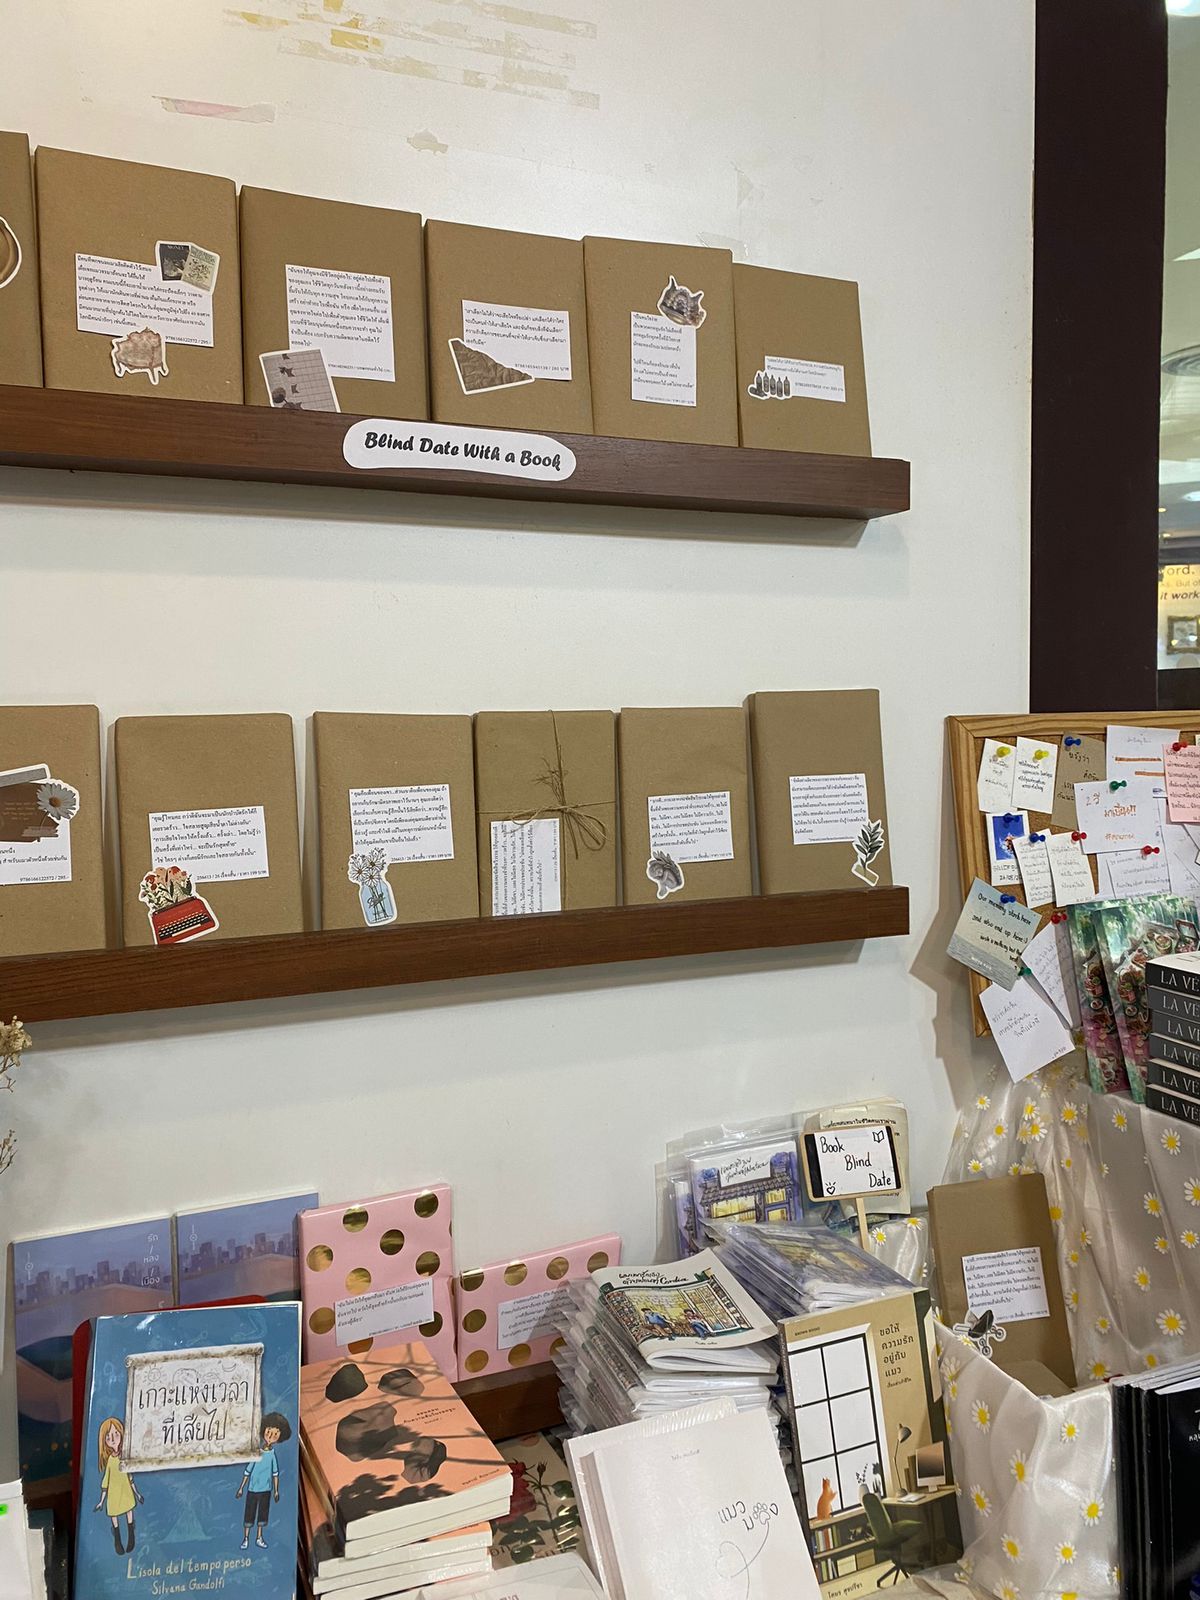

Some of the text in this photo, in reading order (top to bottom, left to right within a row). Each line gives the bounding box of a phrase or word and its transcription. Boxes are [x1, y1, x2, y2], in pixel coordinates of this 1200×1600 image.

[365, 431, 561, 472] Blind Date With a Book
[1161, 971, 1177, 986] LA
[1163, 996, 1179, 1012] LA
[1168, 1020, 1183, 1036] LA
[1163, 1044, 1179, 1060] LA
[1162, 1071, 1178, 1088] LA
[1161, 1097, 1177, 1114] LA
[820, 1136, 845, 1154] Book
[844, 1152, 872, 1171] Blind
[868, 1170, 892, 1188] Date
[147, 1234, 158, 1242] รัก
[144, 1255, 159, 1263] หลง
[880, 1323, 900, 1336] ขอให้
[882, 1335, 914, 1350] ความรัก
[884, 1352, 906, 1364] อยู่กับ
[885, 1367, 901, 1377] แมว
[138, 1378, 249, 1410] เกาะแห่งเวลา
[162, 1407, 226, 1445] ที่เสียไป
[718, 1500, 747, 1524] แมว
[167, 1558, 186, 1575] del
[187, 1558, 221, 1576] tempo
[223, 1557, 252, 1576] perso
[151, 1577, 225, 1596] Silvana Gandolfi
